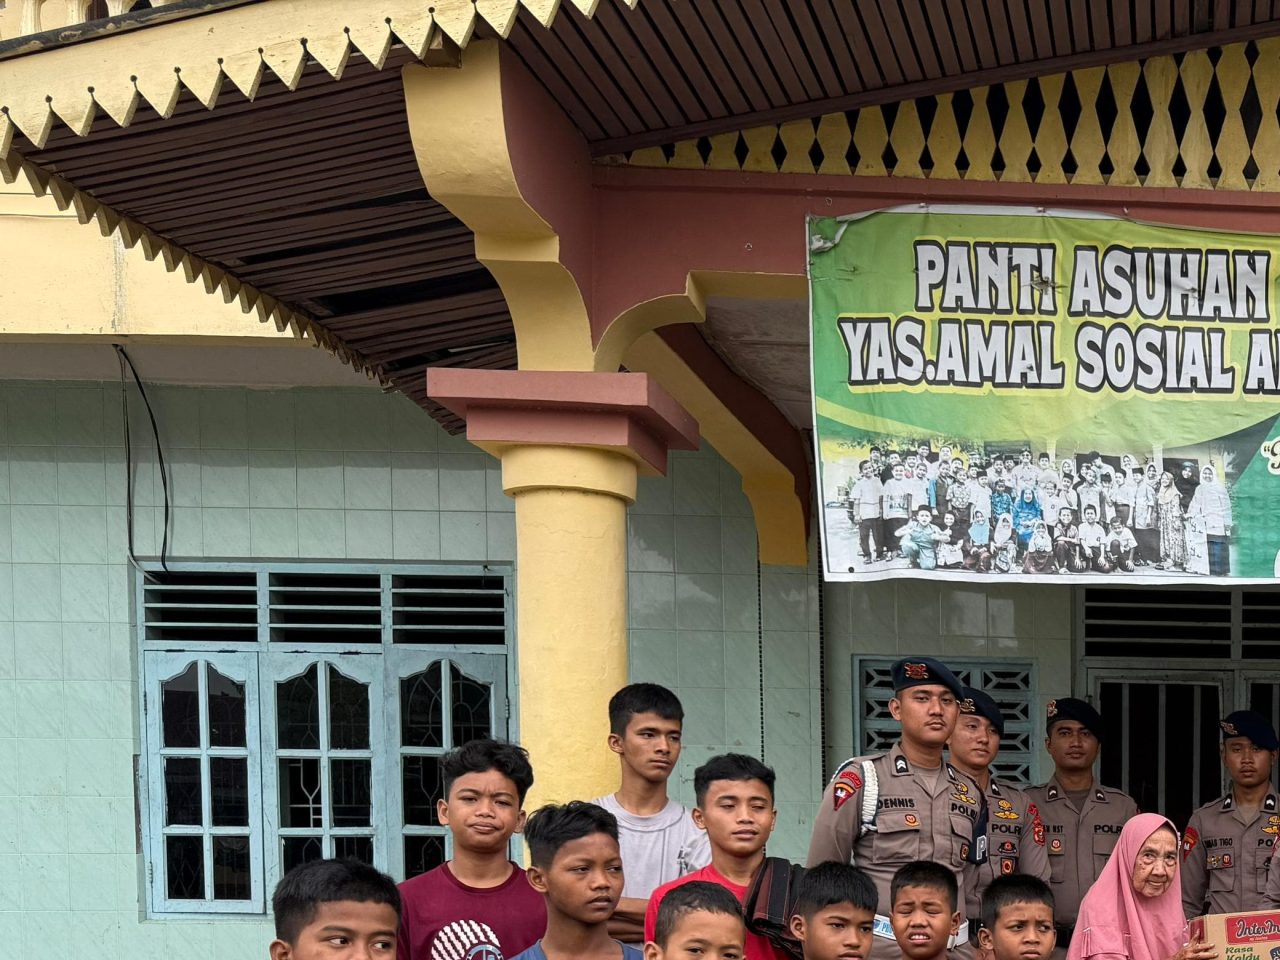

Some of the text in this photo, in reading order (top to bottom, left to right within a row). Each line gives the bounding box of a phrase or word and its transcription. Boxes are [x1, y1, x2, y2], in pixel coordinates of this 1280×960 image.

[914, 241, 1057, 314] PANTI
[1068, 245, 1271, 322] ASUHAN
[838, 317, 1064, 386] YAS.AMAL
[1075, 322, 1235, 393] SOSIAL
[1094, 825, 1124, 834] POLR
